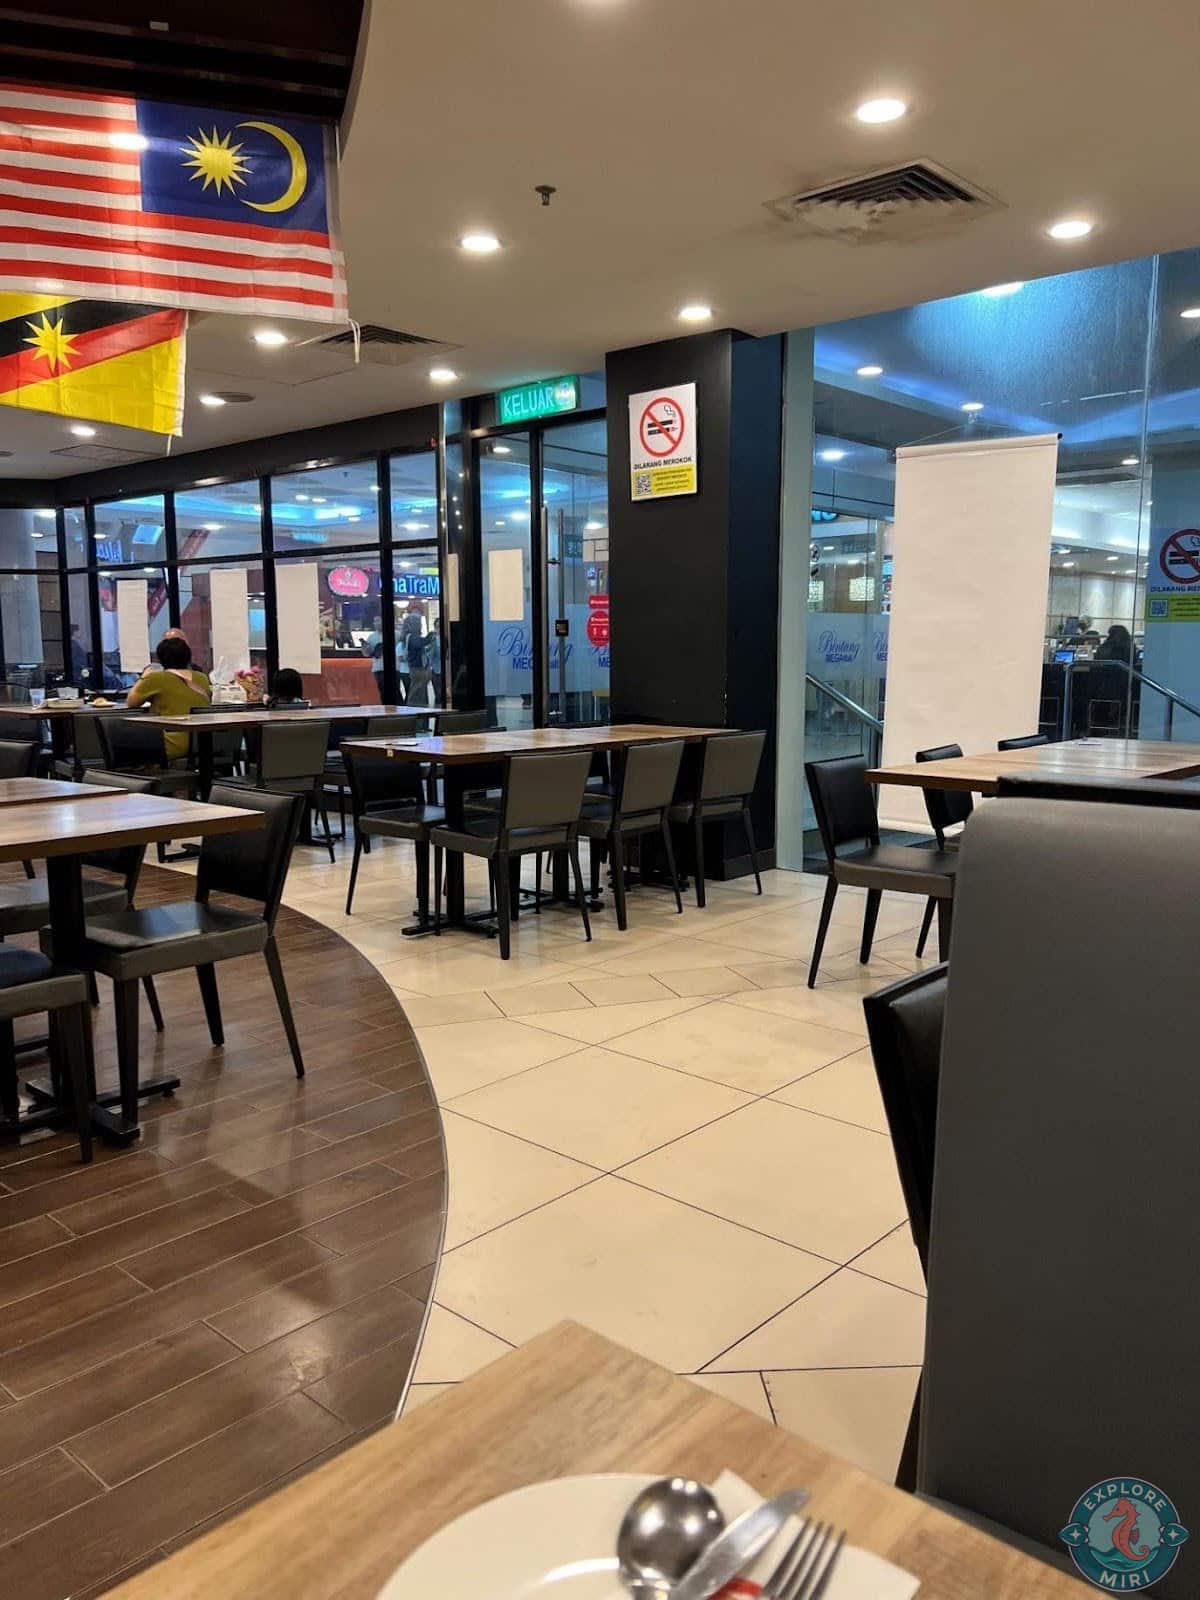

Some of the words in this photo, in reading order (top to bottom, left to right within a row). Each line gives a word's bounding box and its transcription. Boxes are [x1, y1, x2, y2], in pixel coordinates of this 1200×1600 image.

[503, 386, 553, 417] KELUAR
[633, 459, 662, 470] DILARANG
[663, 456, 692, 466] MEROKOK
